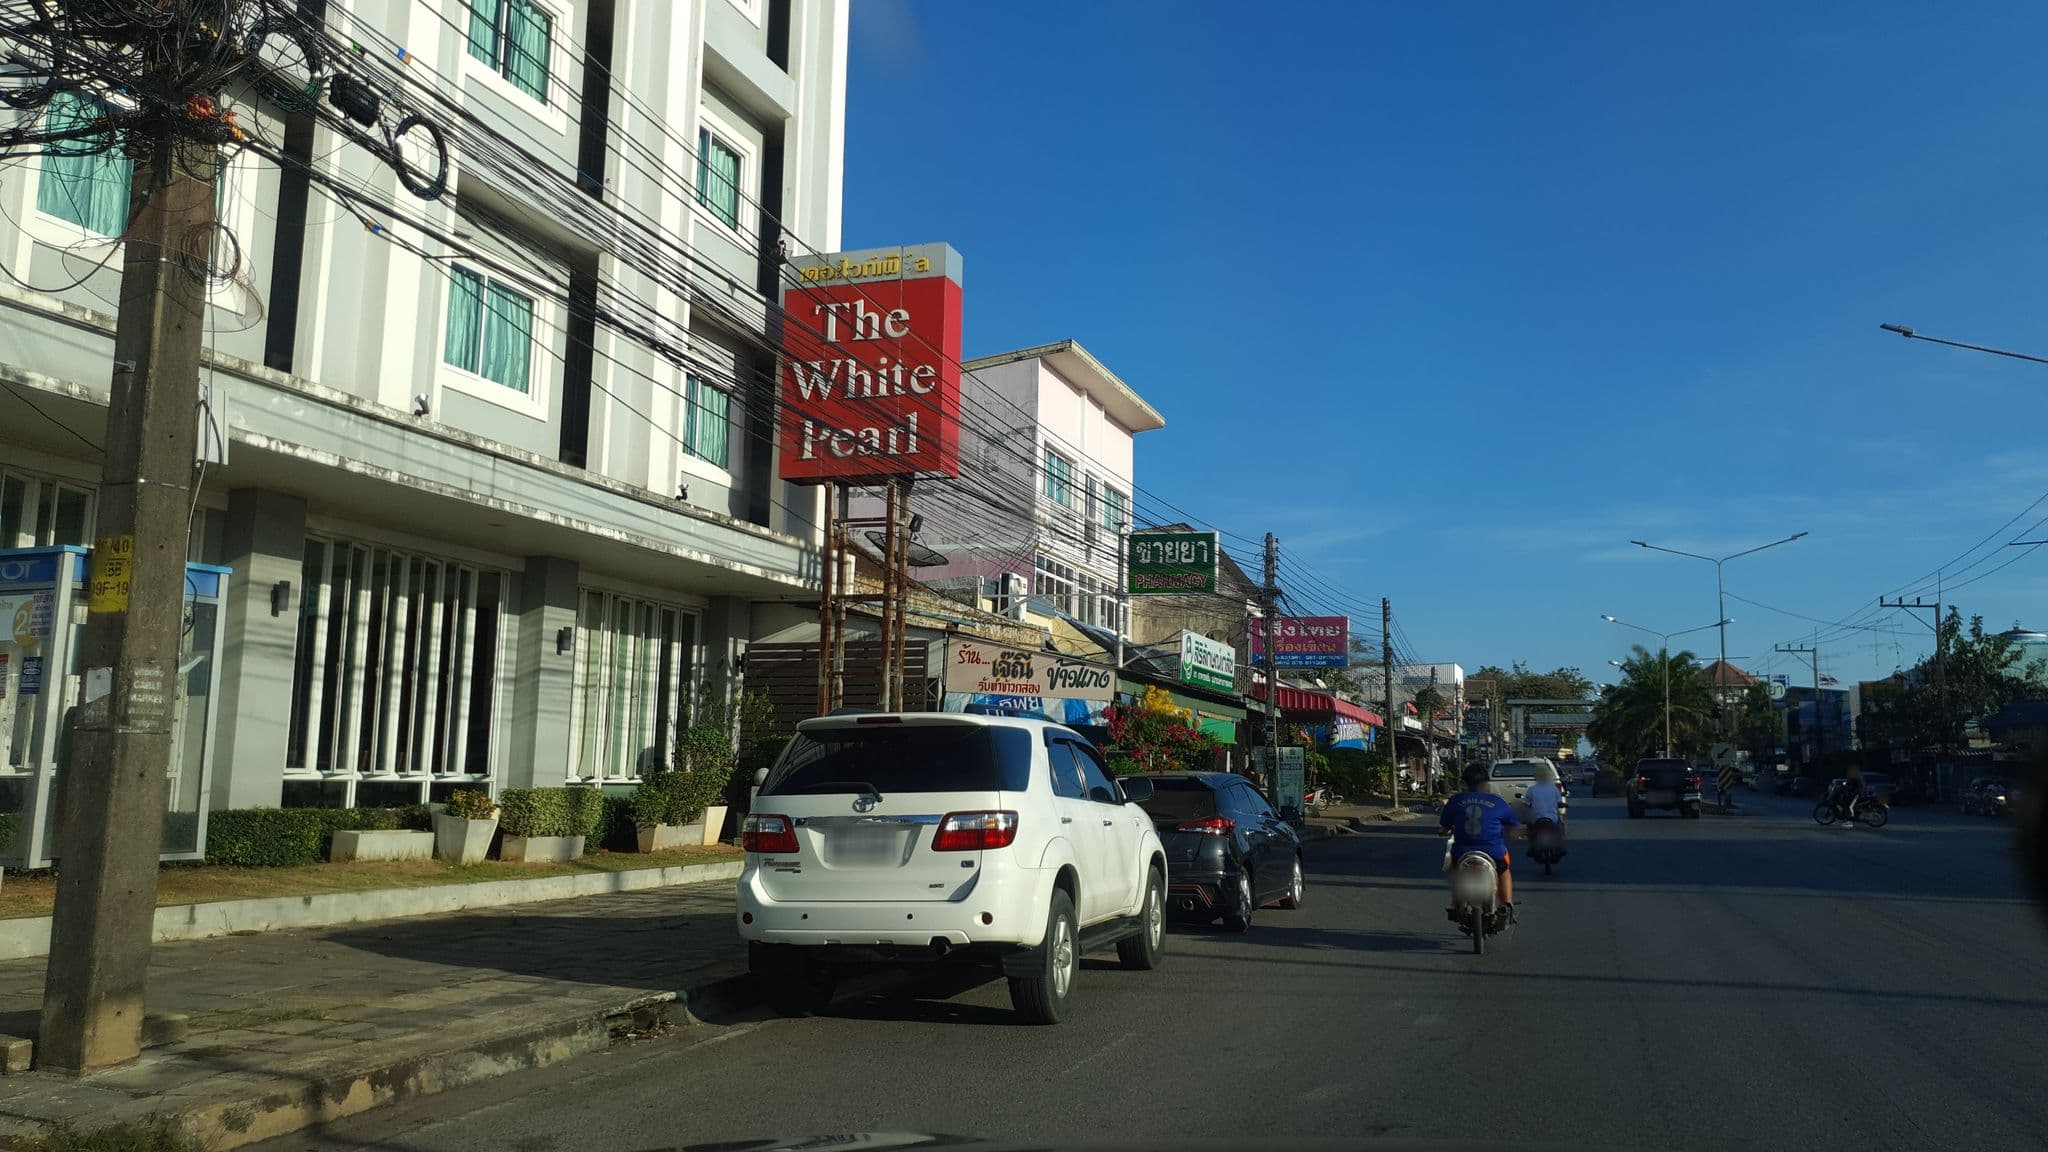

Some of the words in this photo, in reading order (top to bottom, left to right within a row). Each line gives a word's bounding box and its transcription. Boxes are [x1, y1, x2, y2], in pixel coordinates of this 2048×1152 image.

[815, 299, 910, 343] The
[789, 357, 936, 401] White
[799, 411, 921, 460] Pearl
[1135, 540, 1208, 565] ขายยา
[0, 559, 41, 581] OT
[1135, 573, 1208, 590] PHARMACY
[977, 677, 1041, 695] รับทำข้าวกล่อง
[1046, 658, 1110, 690] ข้าวแกง
